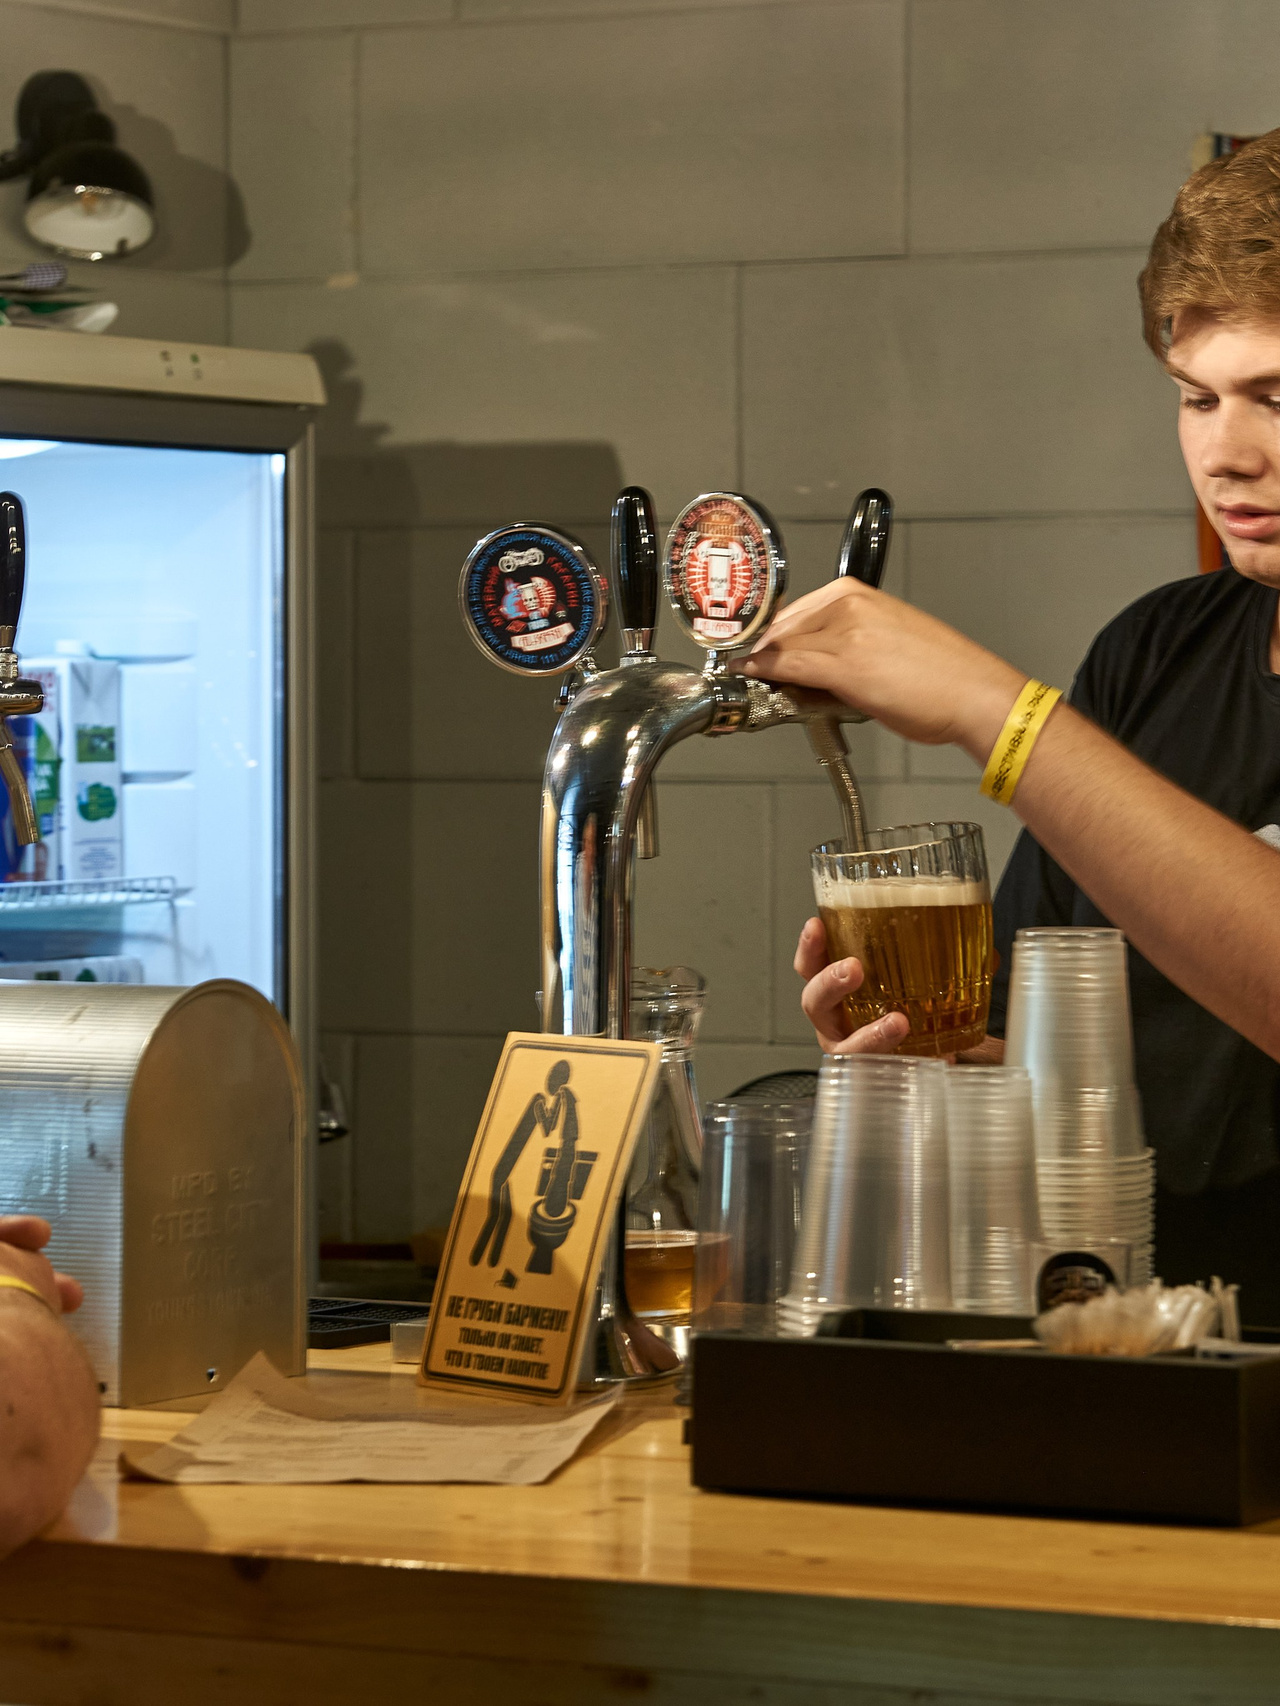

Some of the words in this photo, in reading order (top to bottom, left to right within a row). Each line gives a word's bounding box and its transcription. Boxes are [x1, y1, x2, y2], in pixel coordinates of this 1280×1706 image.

[446, 1295, 464, 1318] НЕ
[463, 1297, 504, 1323] ГРУБИ
[504, 1302, 570, 1332] БАРМЕНУ!
[458, 1327, 497, 1348] ТОЛЬКО
[497, 1332, 512, 1350] ОН
[445, 1349, 463, 1367] ЧТО
[463, 1351, 472, 1368] В
[472, 1353, 505, 1373] ТВОЕМ
